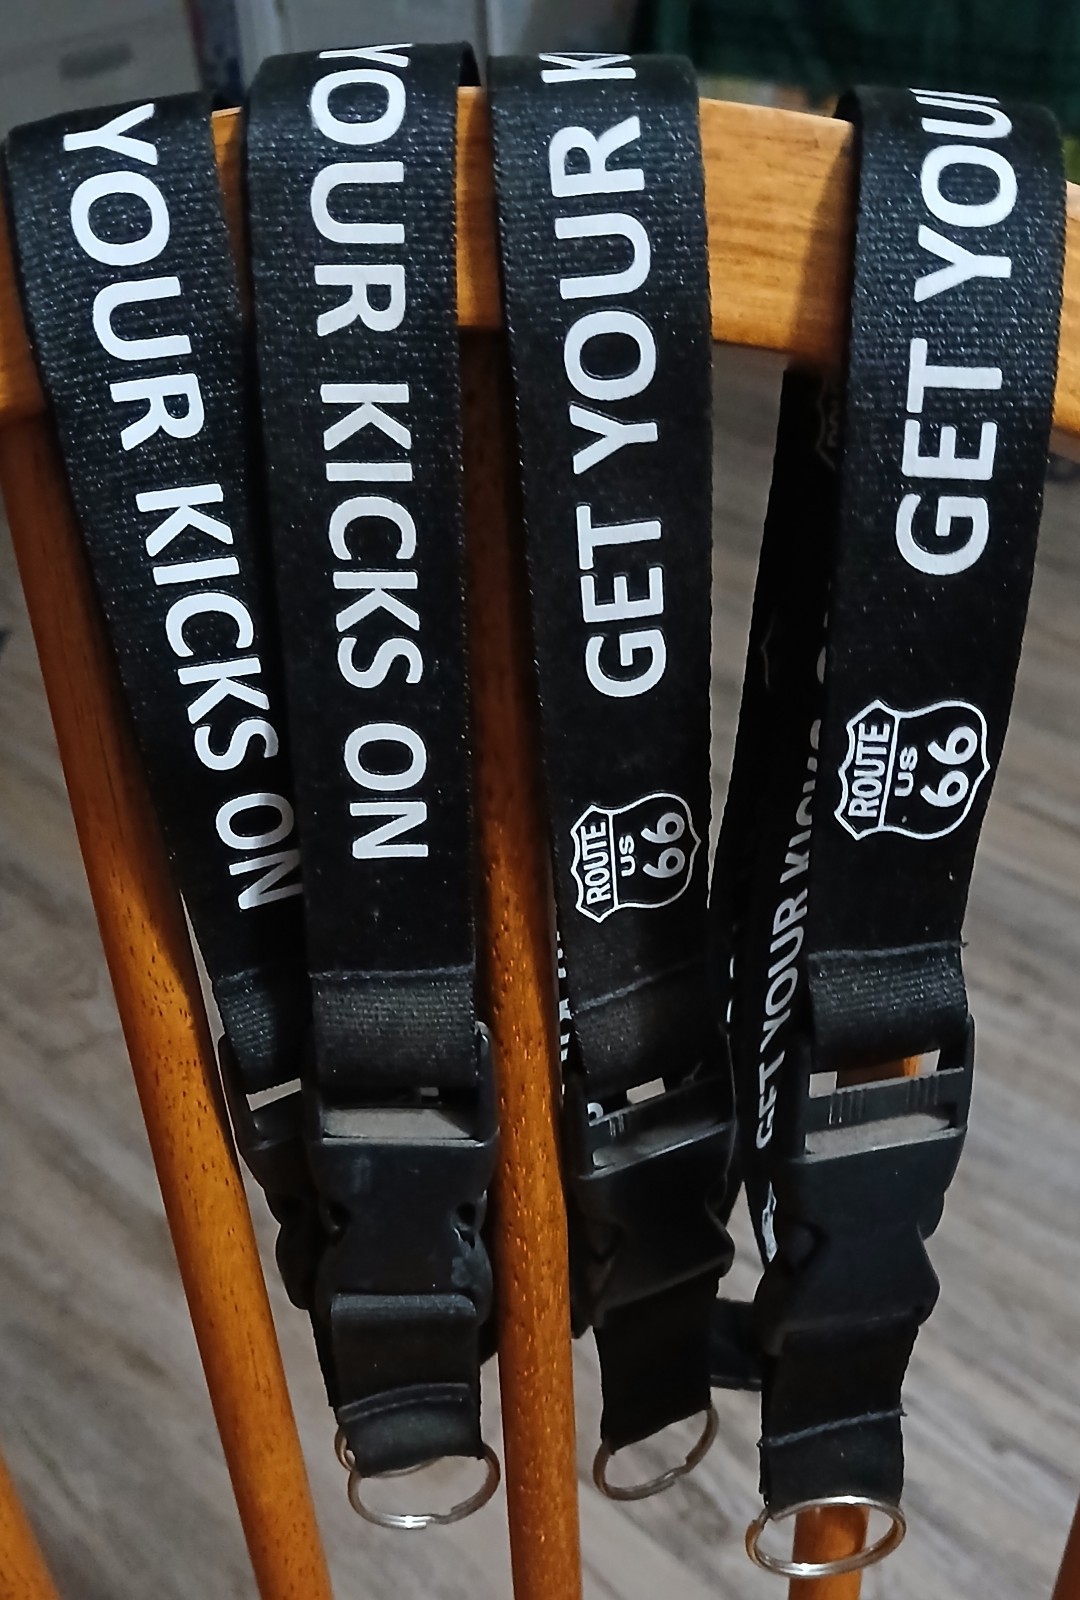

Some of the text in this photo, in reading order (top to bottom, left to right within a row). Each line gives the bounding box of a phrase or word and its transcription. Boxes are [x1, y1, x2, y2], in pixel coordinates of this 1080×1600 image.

[548, 115, 659, 475] YOUR
[895, 87, 1019, 576] GET YOU
[63, 103, 303, 910] YOUR KICKS ON
[310, 43, 429, 860] YOUR KICKS ON
[575, 504, 667, 698] GET
[847, 722, 891, 818] ROUTE
[894, 746, 918, 797] US
[920, 725, 978, 808] 66
[580, 821, 612, 905] ROUTE
[619, 834, 636, 877] US
[641, 812, 685, 879] 66
[759, 888, 809, 1053] YOUR
